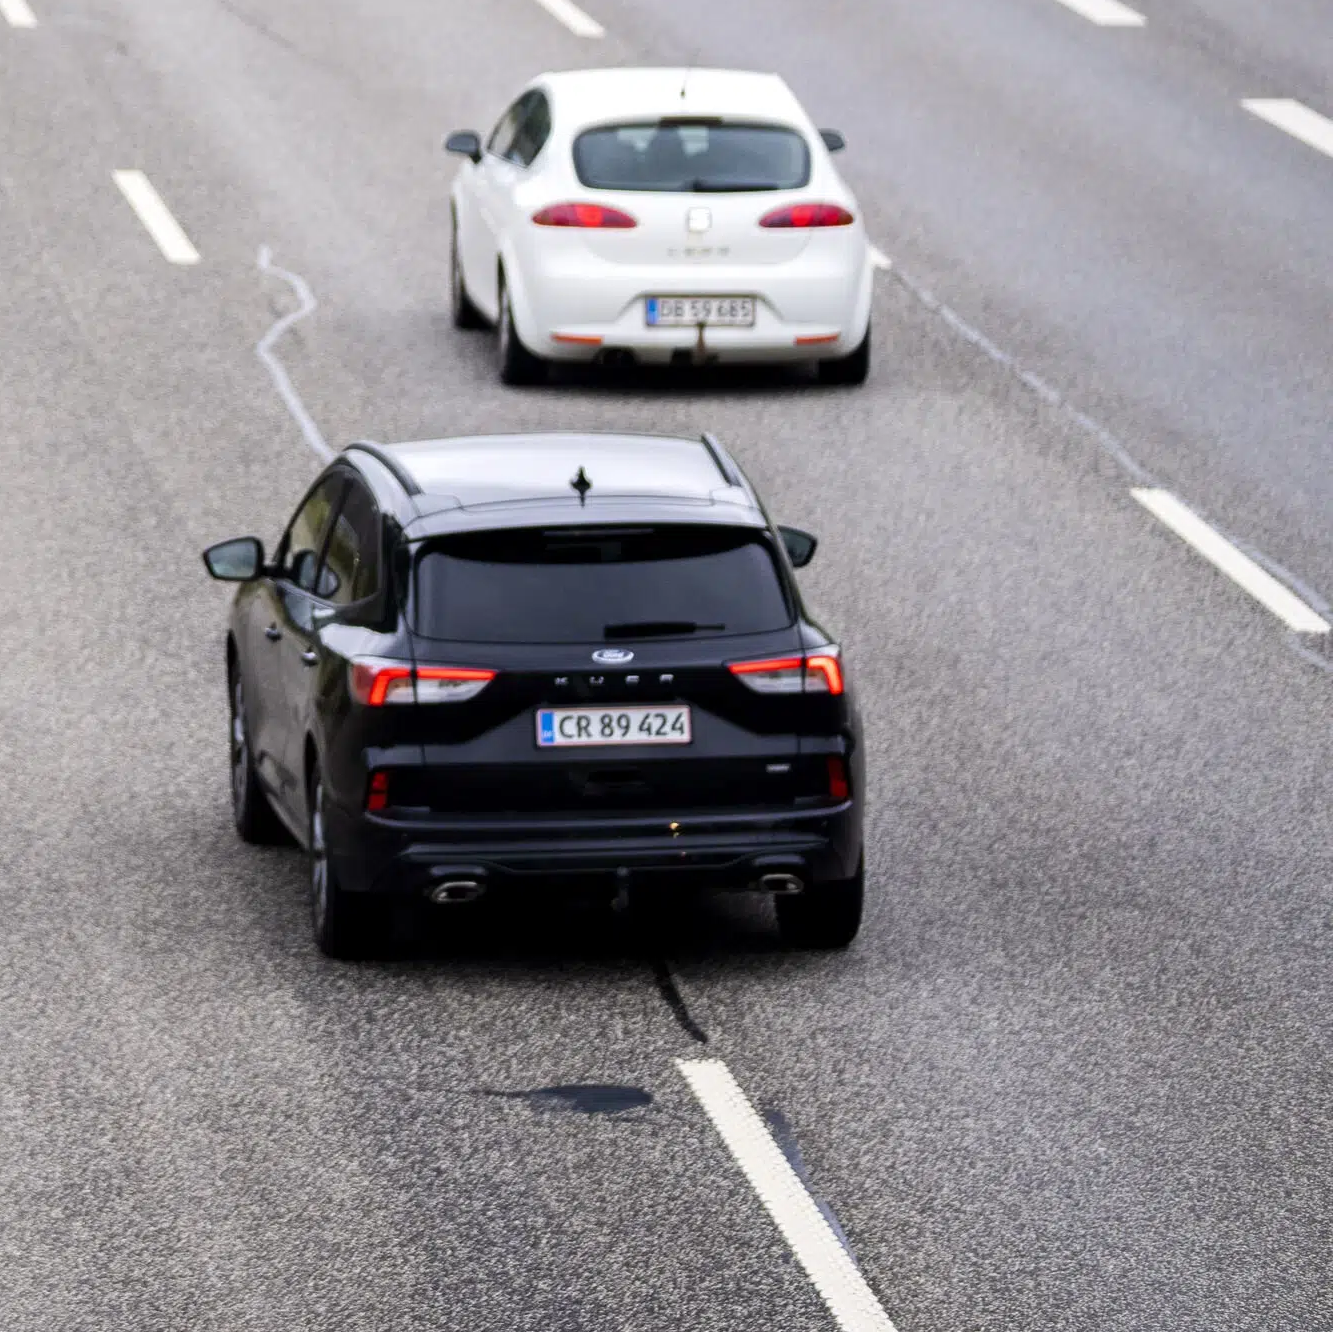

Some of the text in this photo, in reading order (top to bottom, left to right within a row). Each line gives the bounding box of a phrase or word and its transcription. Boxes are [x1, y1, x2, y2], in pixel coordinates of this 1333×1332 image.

[559, 711, 686, 739] CR 89 424
